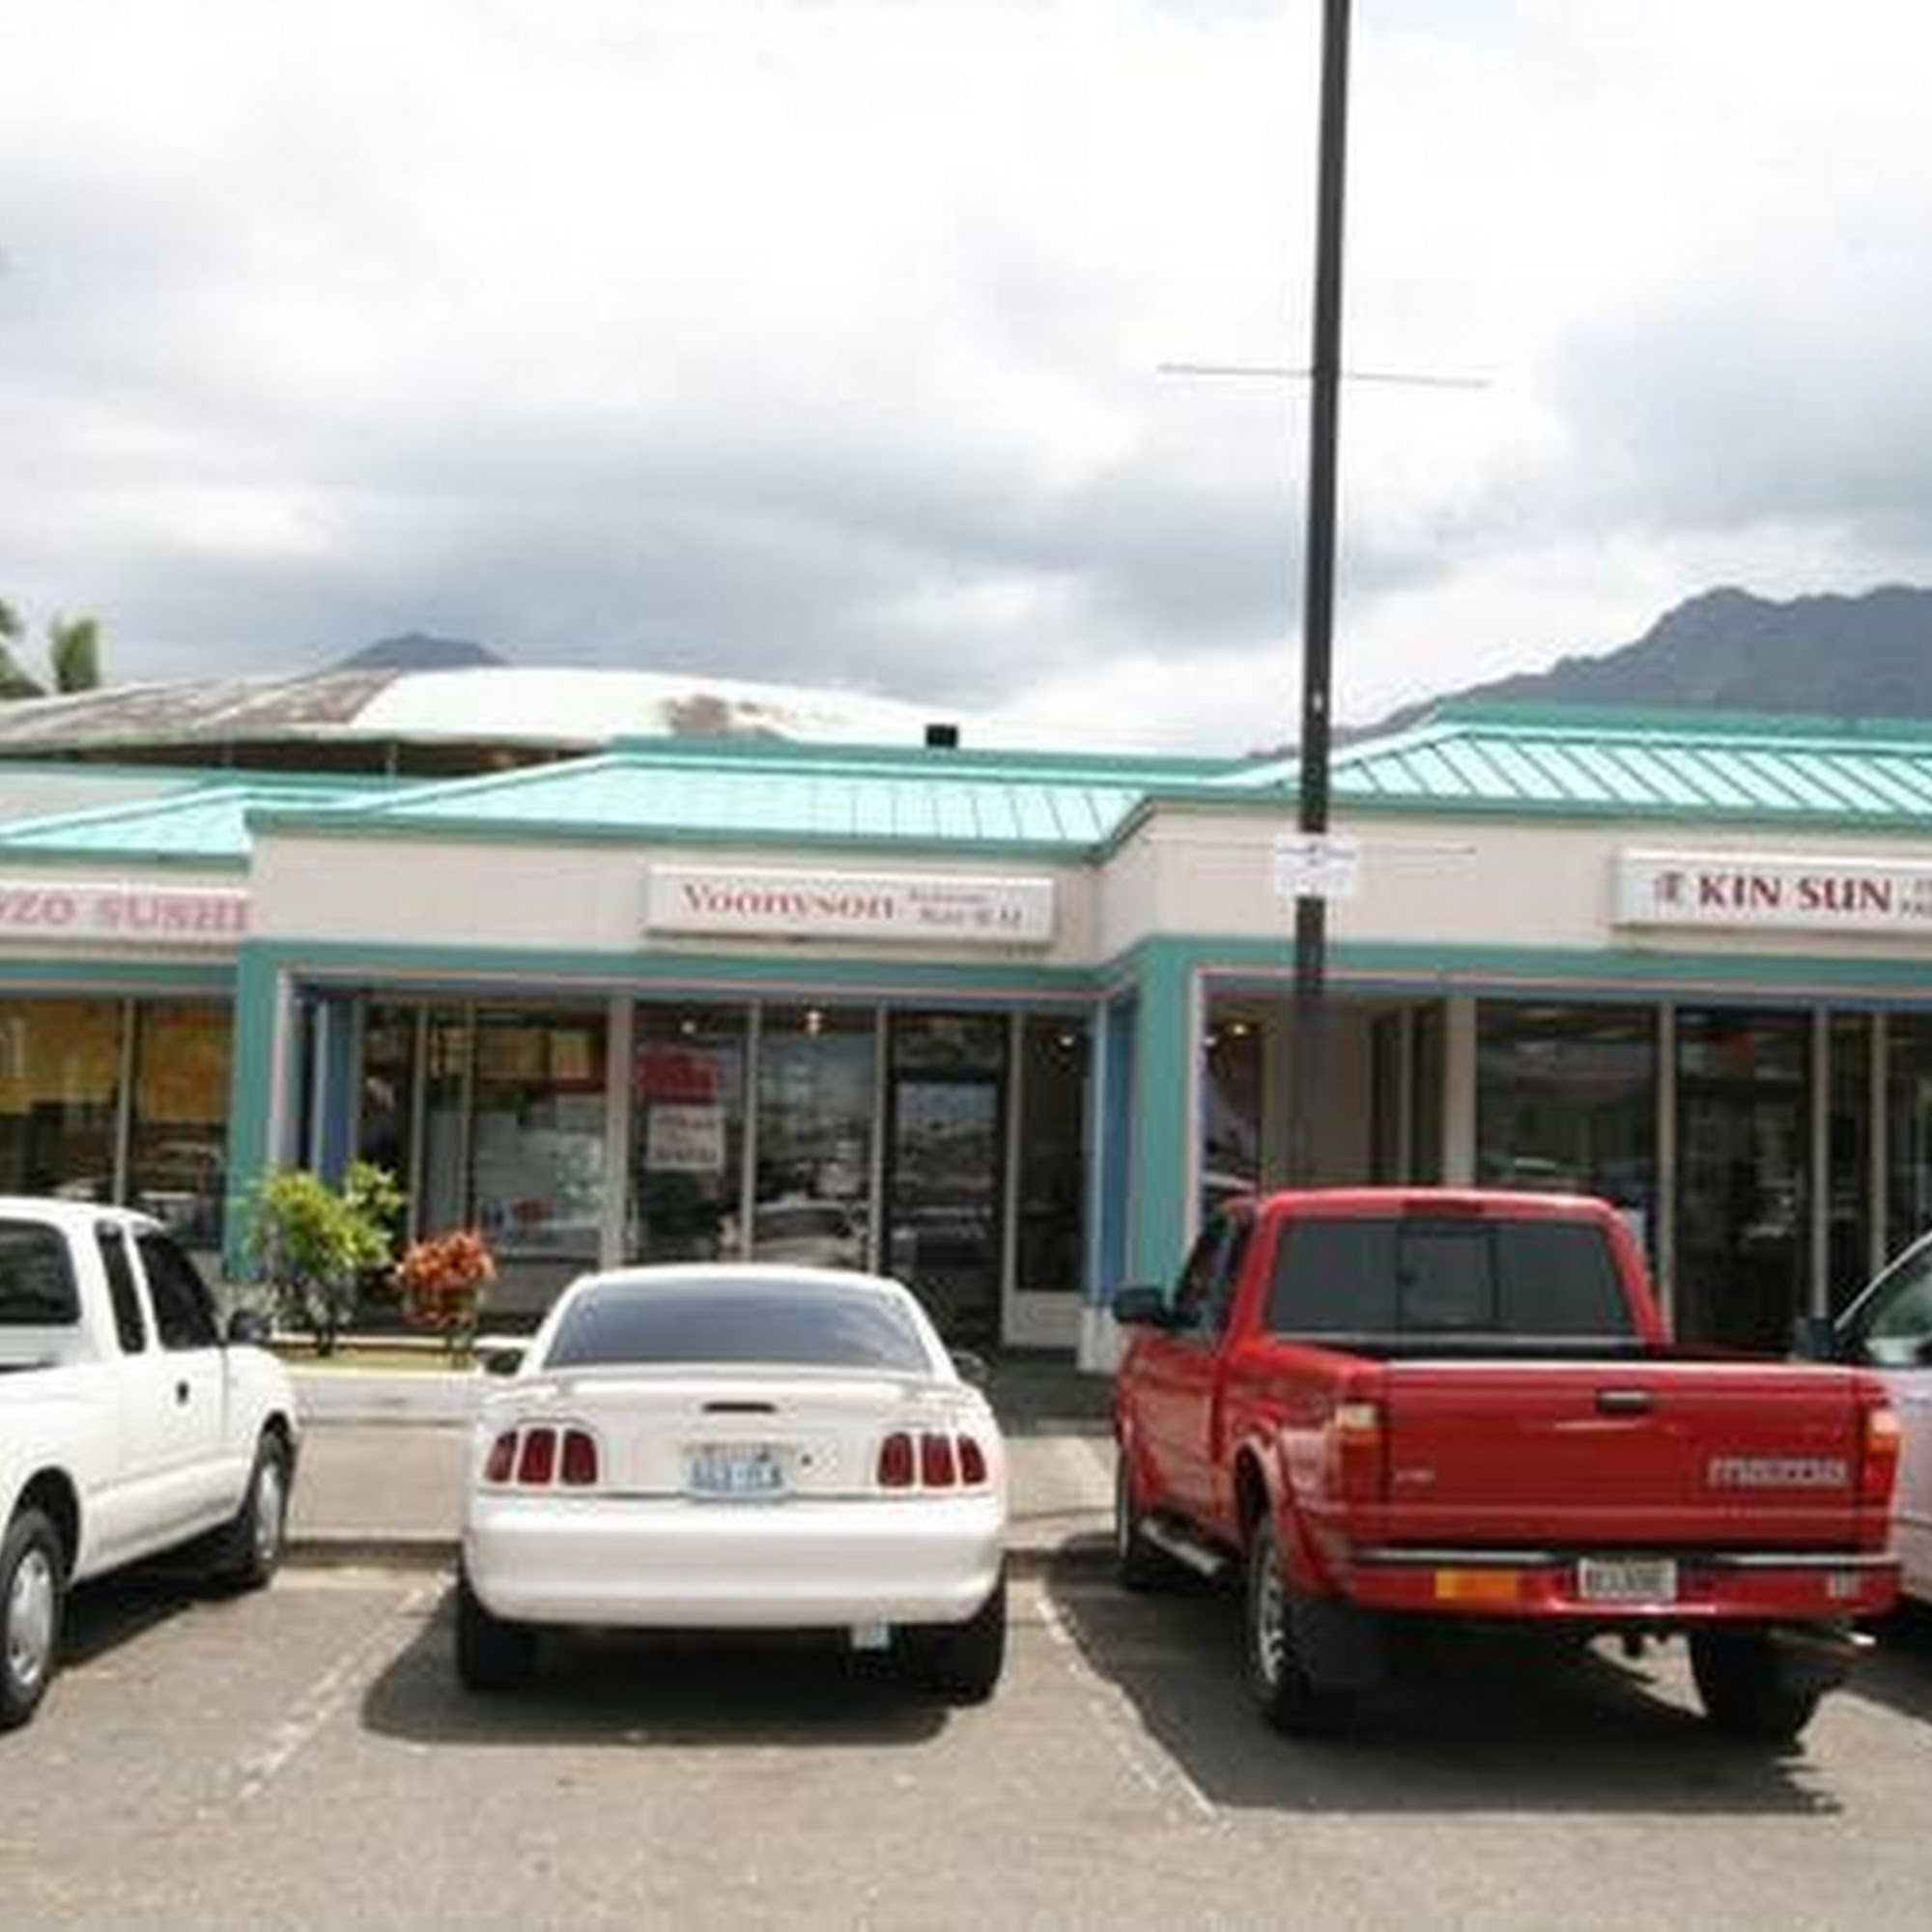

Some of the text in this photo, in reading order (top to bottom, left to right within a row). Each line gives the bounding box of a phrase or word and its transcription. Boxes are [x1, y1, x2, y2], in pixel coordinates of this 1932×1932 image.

[98, 893, 248, 931] SUSHI
[1697, 873, 1781, 908] KIN
[1798, 876, 1892, 913] SUN
